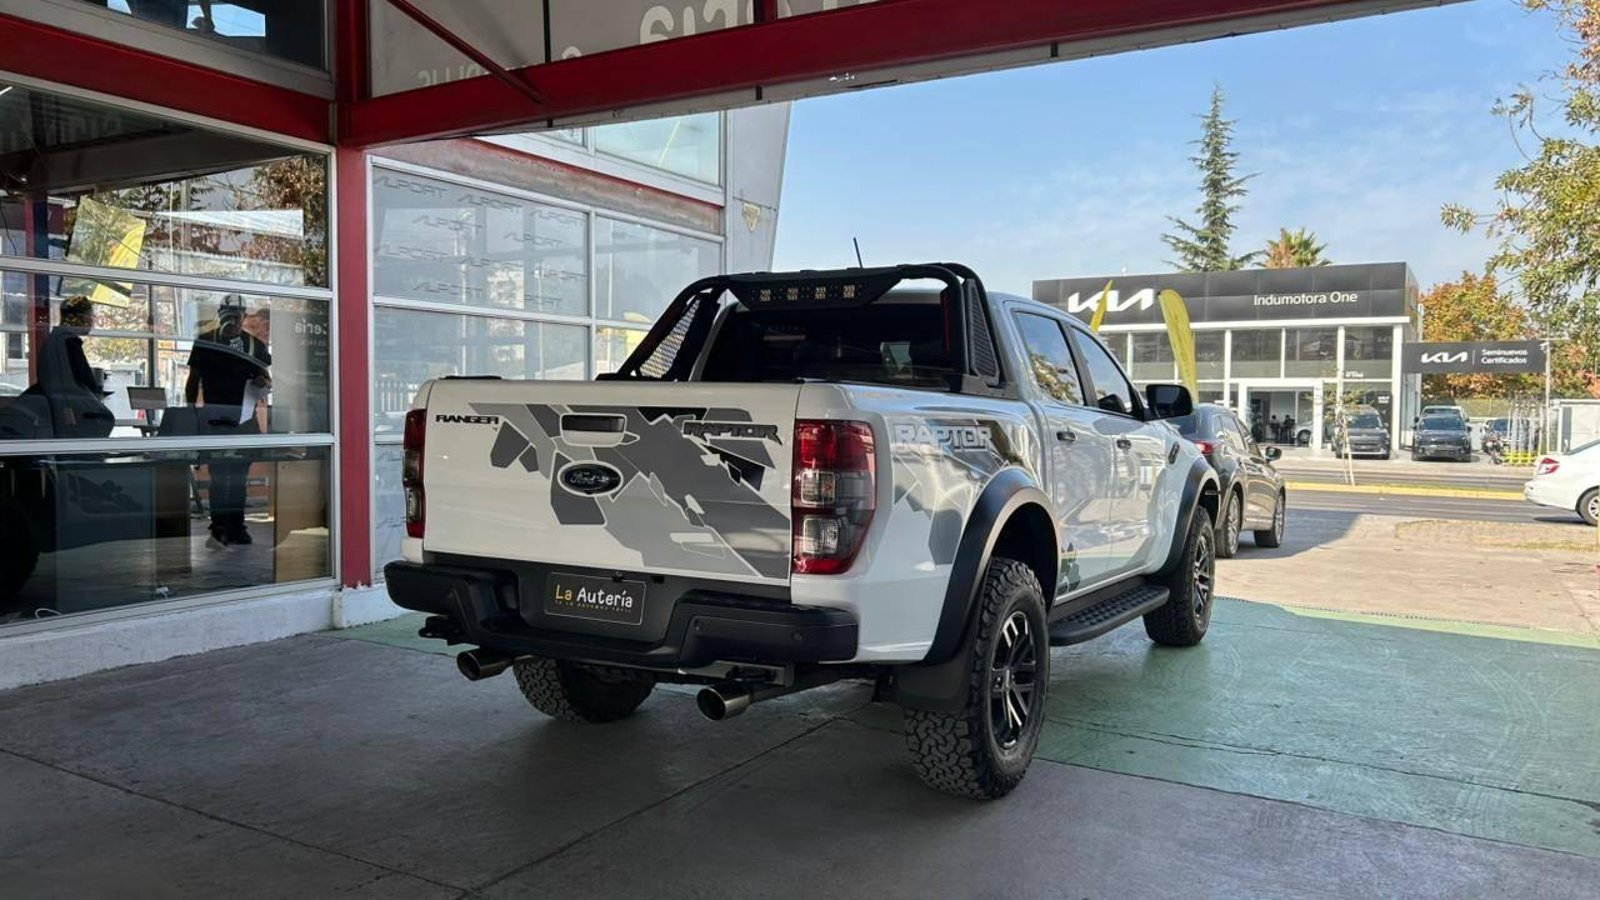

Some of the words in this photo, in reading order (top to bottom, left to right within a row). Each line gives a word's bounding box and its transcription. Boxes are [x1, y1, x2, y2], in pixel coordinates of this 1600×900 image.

[1068, 288, 1154, 313] KIA
[1254, 294, 1327, 306] Indumotora
[1330, 291, 1358, 303] One
[1421, 351, 1468, 364] KIA
[1481, 356, 1528, 365] Certificados
[436, 414, 499, 425] RANGER
[683, 422, 782, 446] RAPTOR
[895, 424, 992, 449] RAPTOR
[556, 584, 572, 600] La
[577, 586, 632, 608] Autería
